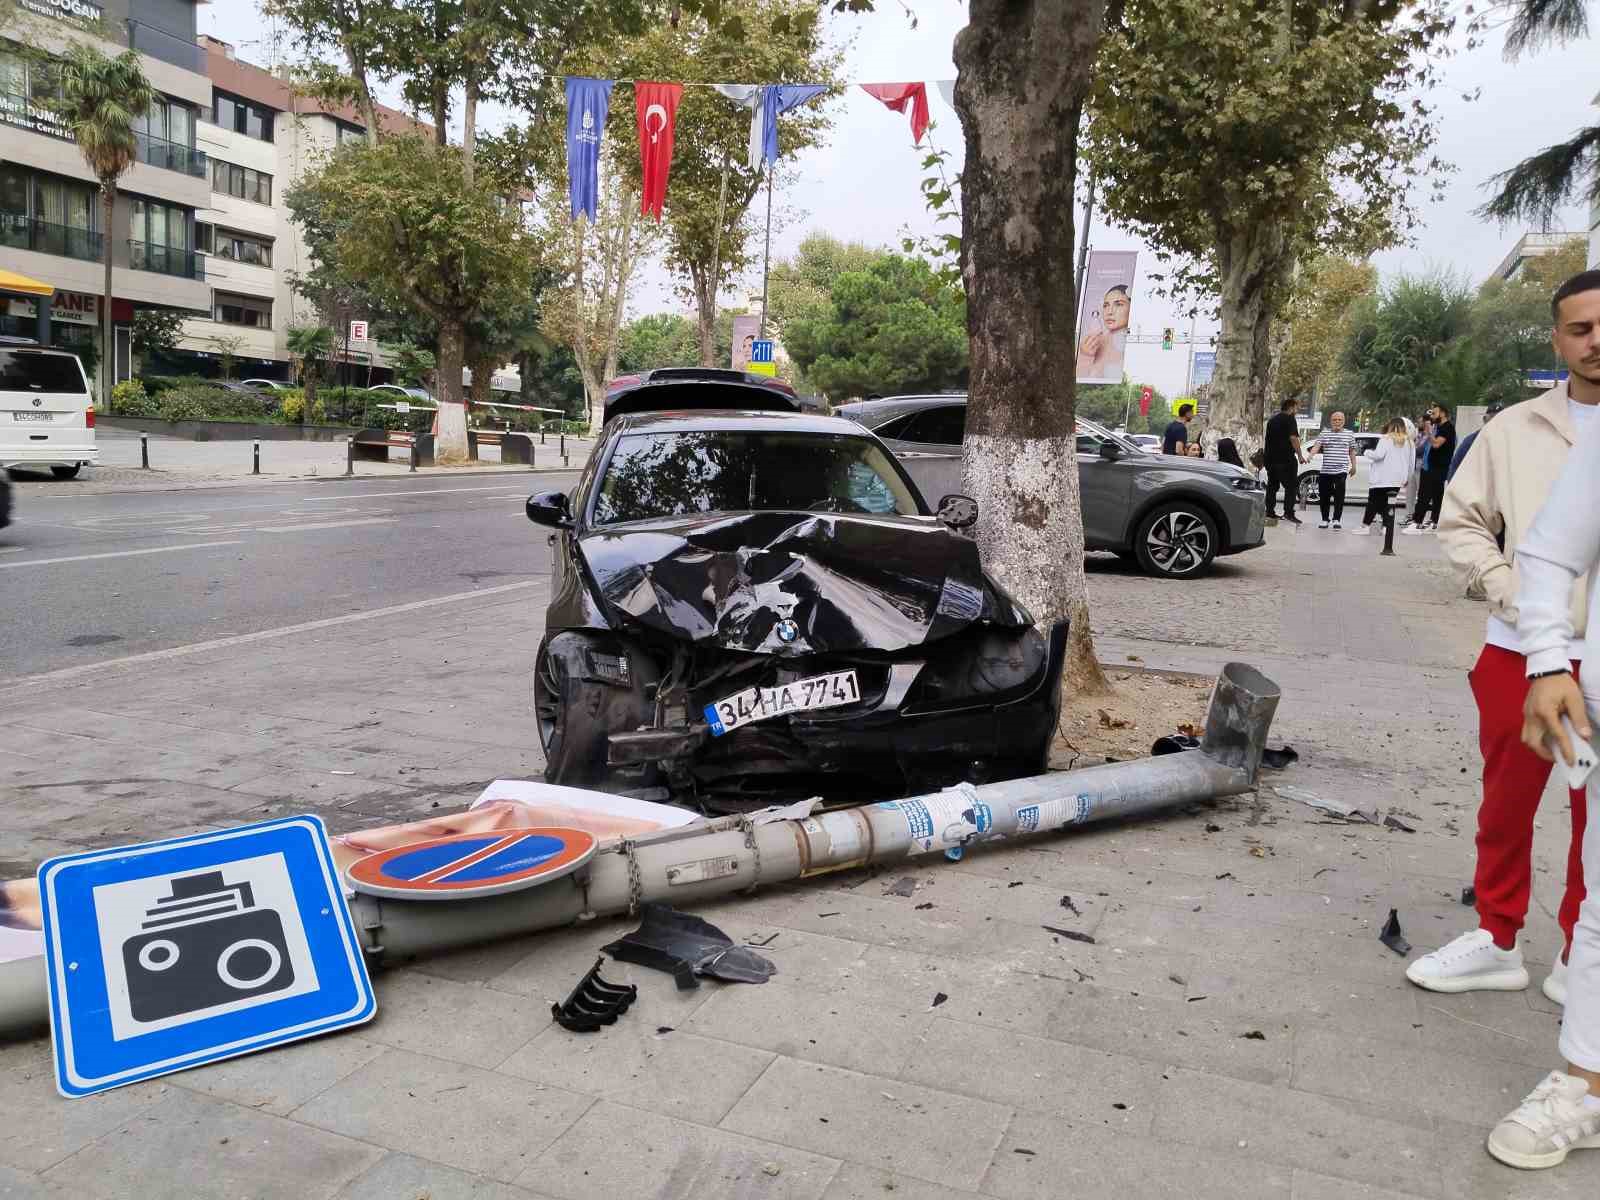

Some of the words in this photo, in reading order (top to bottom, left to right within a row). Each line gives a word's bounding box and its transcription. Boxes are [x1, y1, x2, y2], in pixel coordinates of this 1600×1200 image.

[711, 721, 722, 732] TR
[719, 695, 753, 727] 34
[801, 674, 858, 706] 7741
